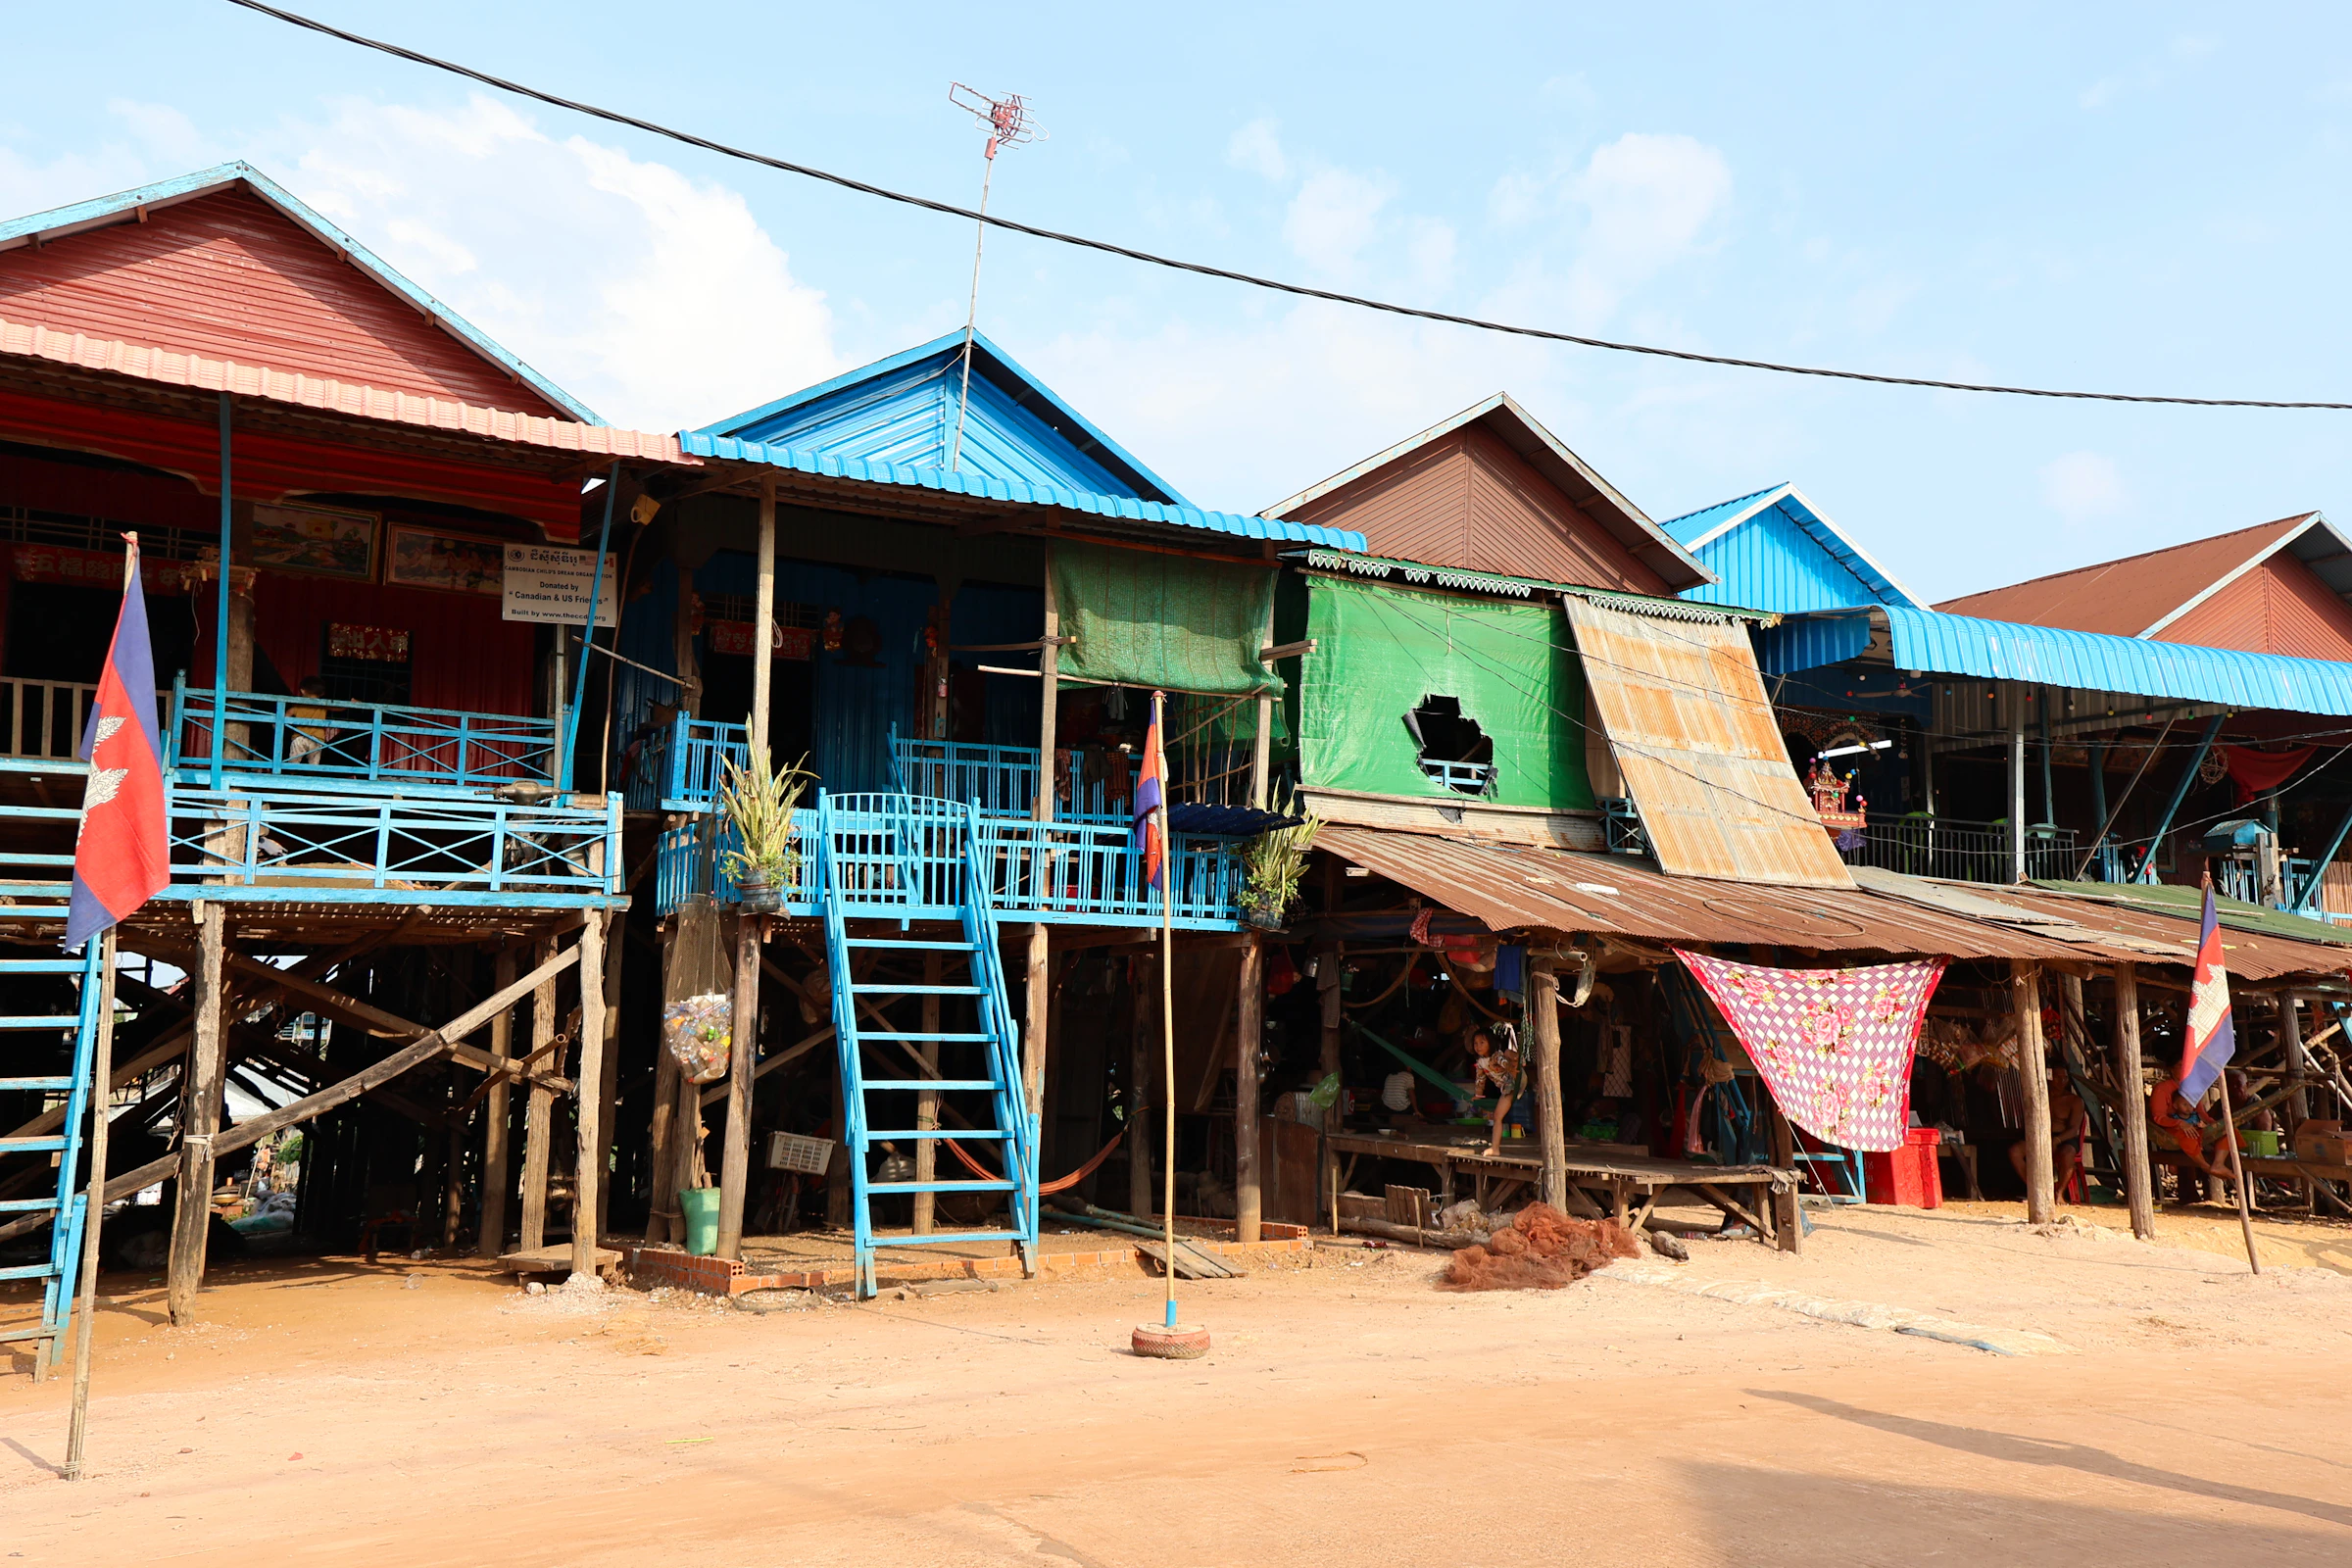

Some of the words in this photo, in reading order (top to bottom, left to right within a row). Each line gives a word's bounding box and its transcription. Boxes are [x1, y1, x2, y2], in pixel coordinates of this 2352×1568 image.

[540, 582, 568, 590] Donated
[571, 583, 579, 592] by
[515, 591, 551, 601] Canadian
